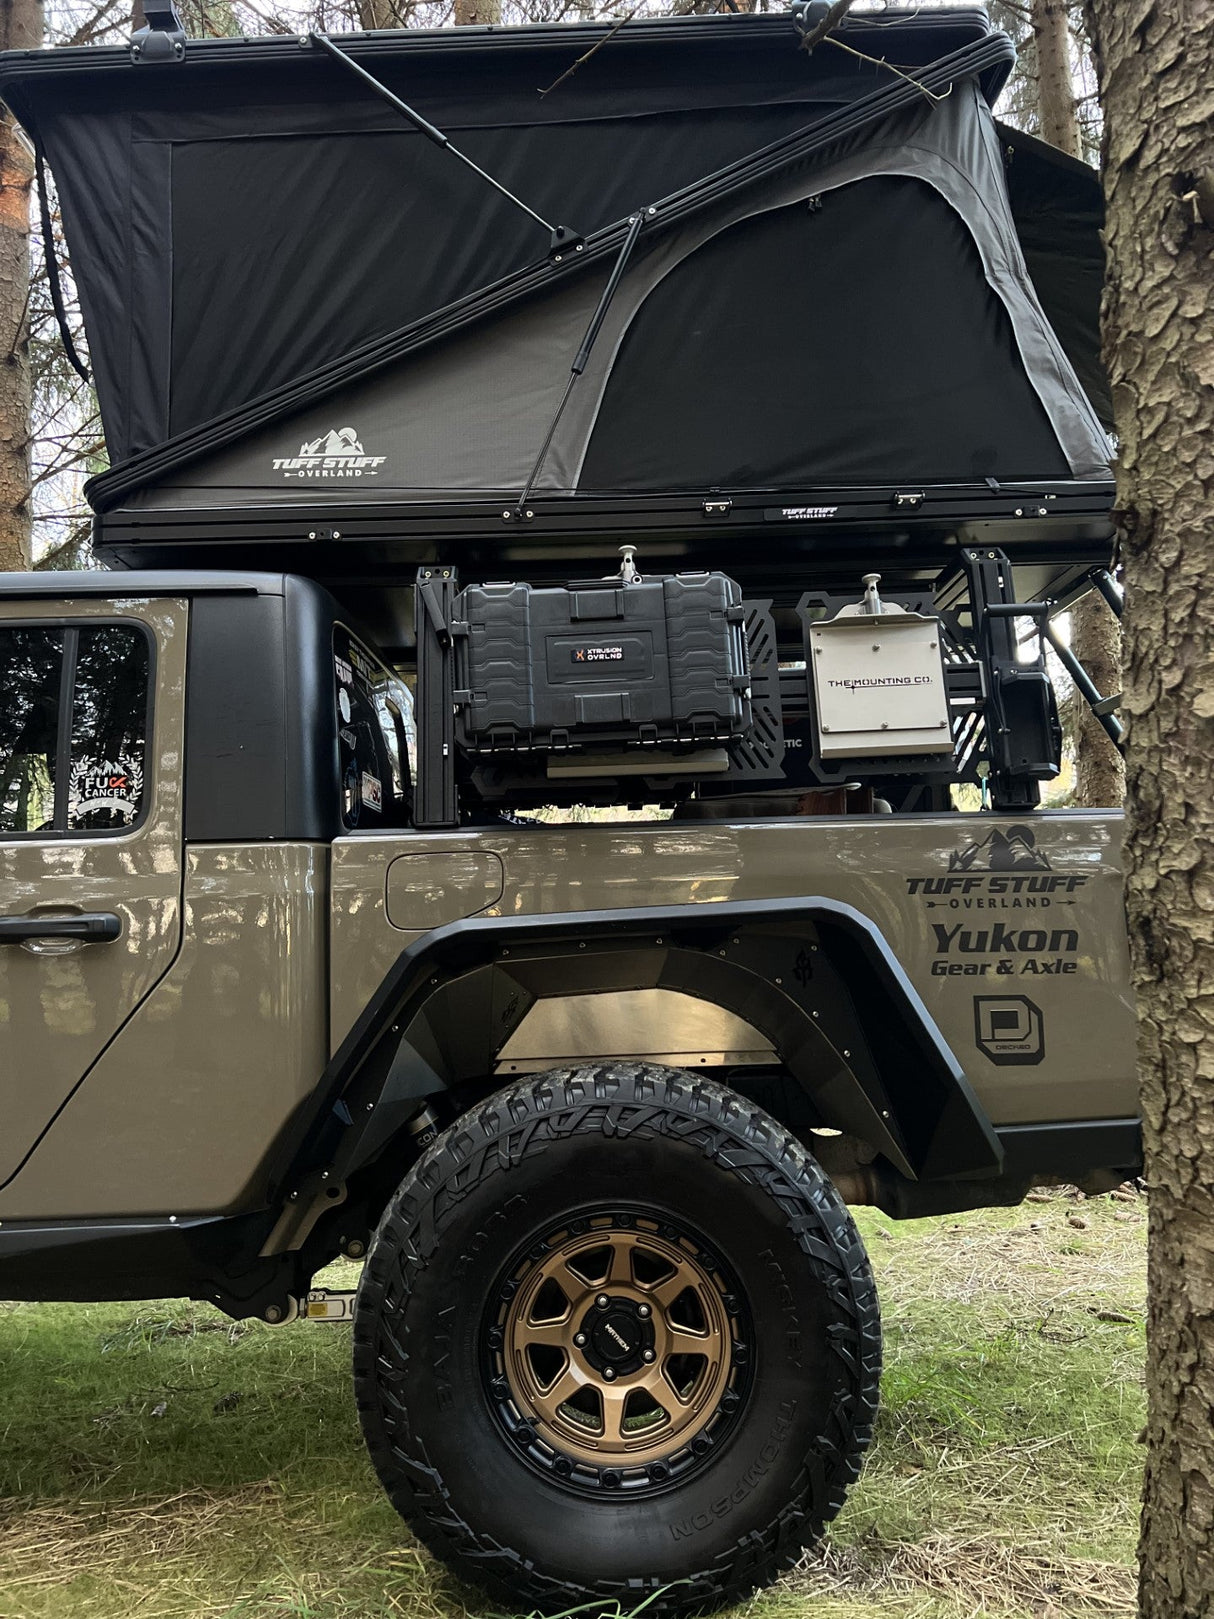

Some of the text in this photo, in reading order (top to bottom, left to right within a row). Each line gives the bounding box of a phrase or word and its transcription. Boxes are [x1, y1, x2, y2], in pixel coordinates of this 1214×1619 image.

[272, 456, 388, 470] TUFF STUFF
[298, 469, 362, 478] OVERLAND
[587, 653, 623, 661] OVRLND
[854, 677, 912, 686] MOUNTING
[85, 788, 127, 798] CANCER
[906, 875, 1089, 895] TUFF STUFF
[949, 897, 1051, 909] OVERLAND
[931, 923, 1079, 954] Yukon
[931, 958, 1077, 977] Gear & Axle
[669, 1399, 800, 1541] THOMPSON
